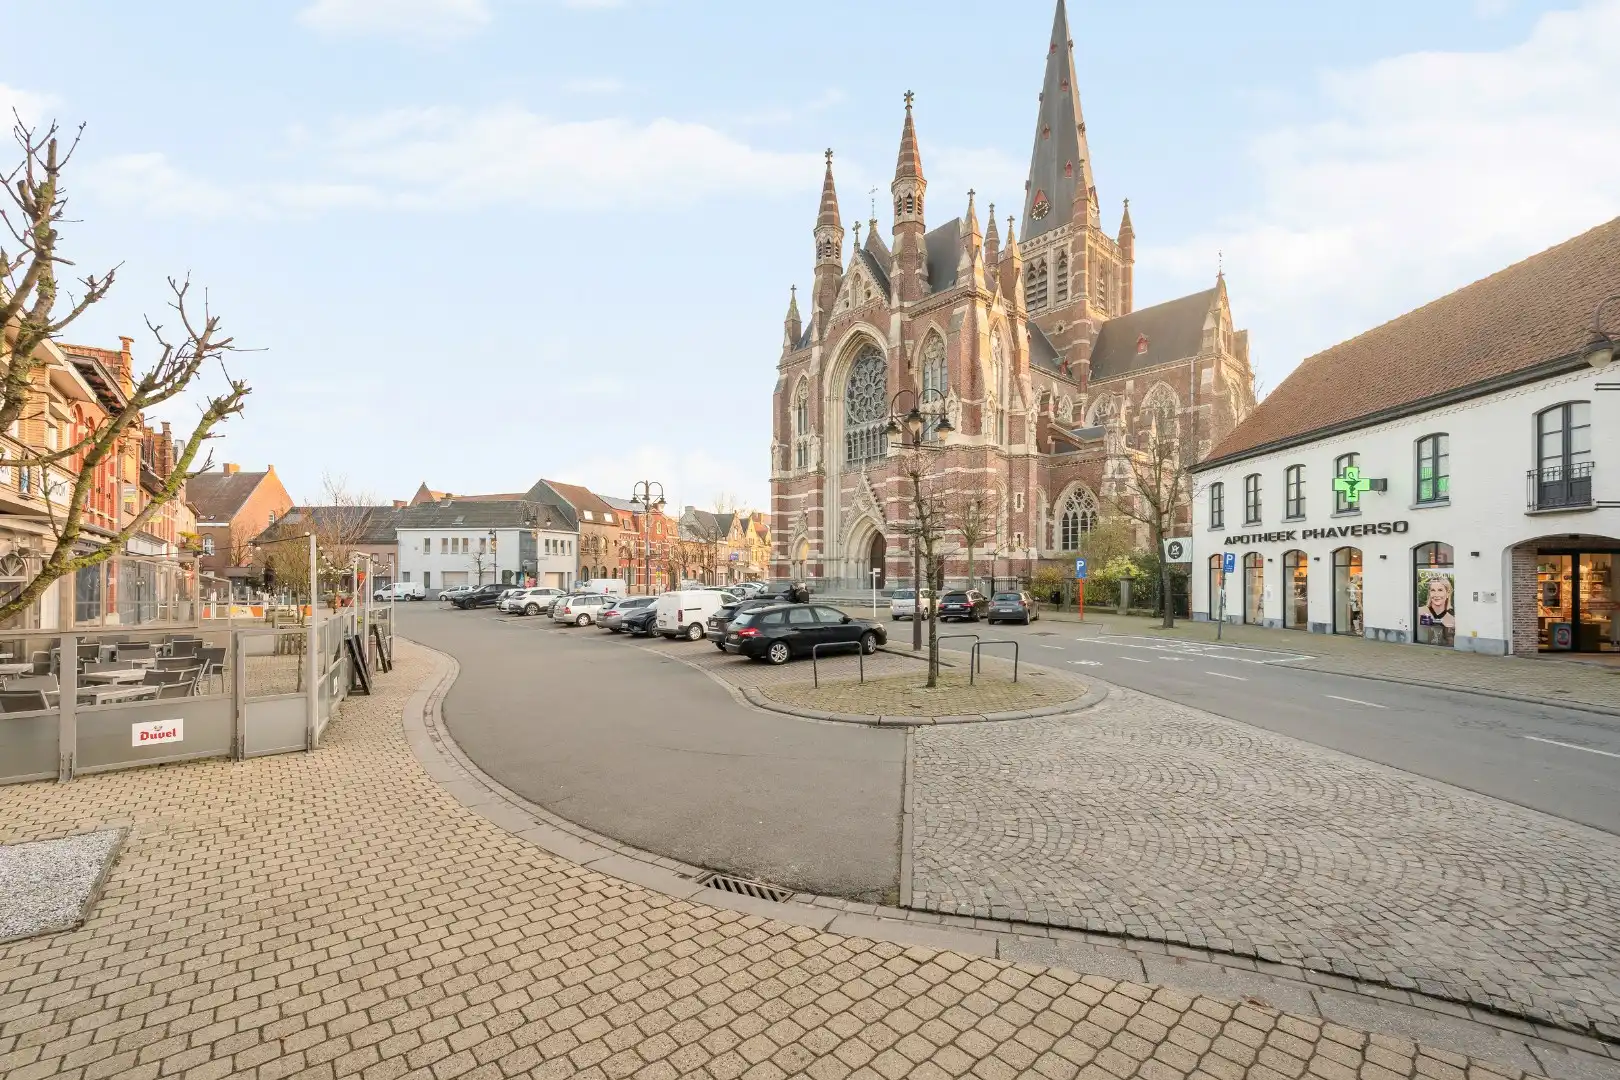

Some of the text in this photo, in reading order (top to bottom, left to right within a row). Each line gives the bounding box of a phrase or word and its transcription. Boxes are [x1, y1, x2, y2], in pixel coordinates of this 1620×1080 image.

[1224, 520, 1409, 545] APOTHEEK PHAVERSO
[140, 728, 176, 740] Duvel
